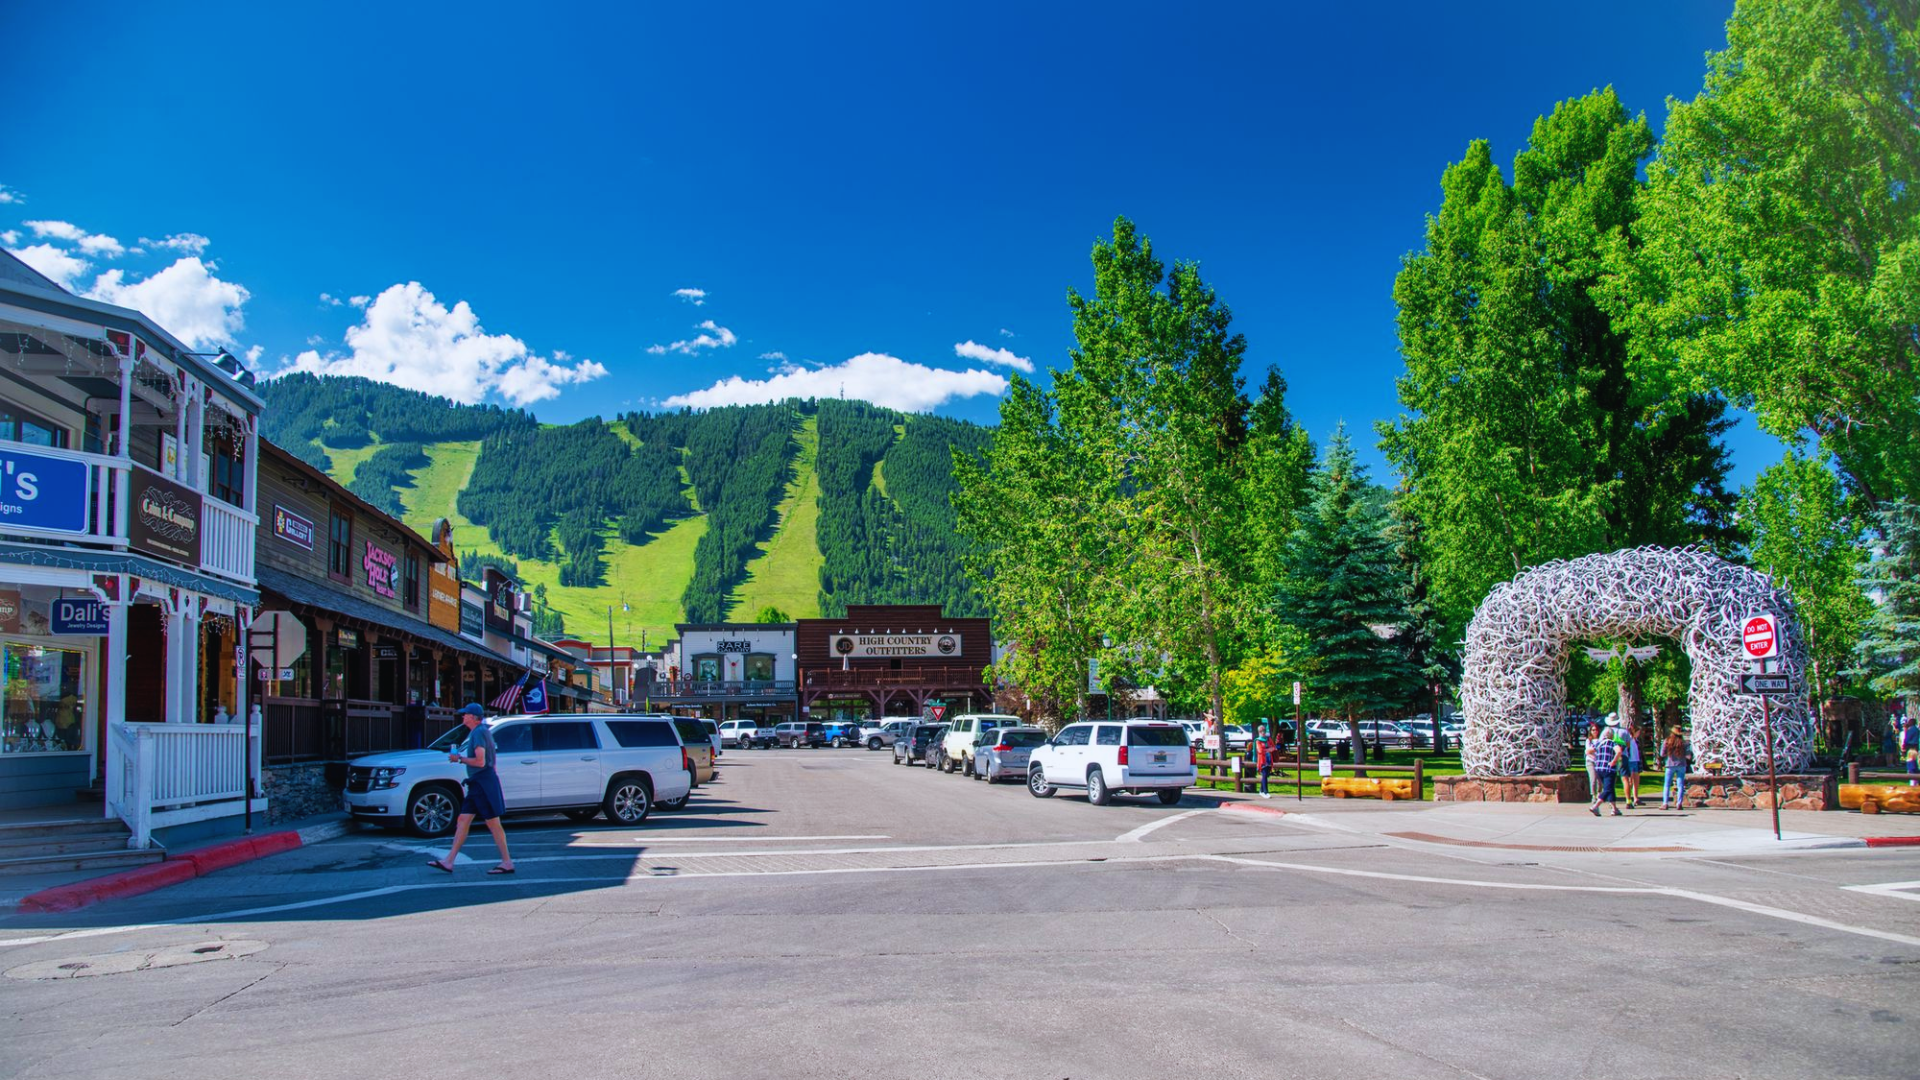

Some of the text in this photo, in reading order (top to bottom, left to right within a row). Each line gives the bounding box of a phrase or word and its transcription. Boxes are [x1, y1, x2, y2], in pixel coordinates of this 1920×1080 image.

[0, 460, 39, 501] 's
[363, 540, 397, 571] JACKSON
[368, 562, 388, 588] HOLE
[60, 602, 110, 622] Dali's
[67, 623, 107, 632] Jewelry Designs
[1747, 623, 1768, 634] DO NOT
[718, 641, 750, 649] RARE
[859, 637, 885, 646] HIGH
[887, 636, 933, 646] COUNTRY
[1750, 641, 1769, 651] ENTER
[866, 646, 927, 655] OUTFITTERS
[1754, 679, 1785, 689] ONE WAY
